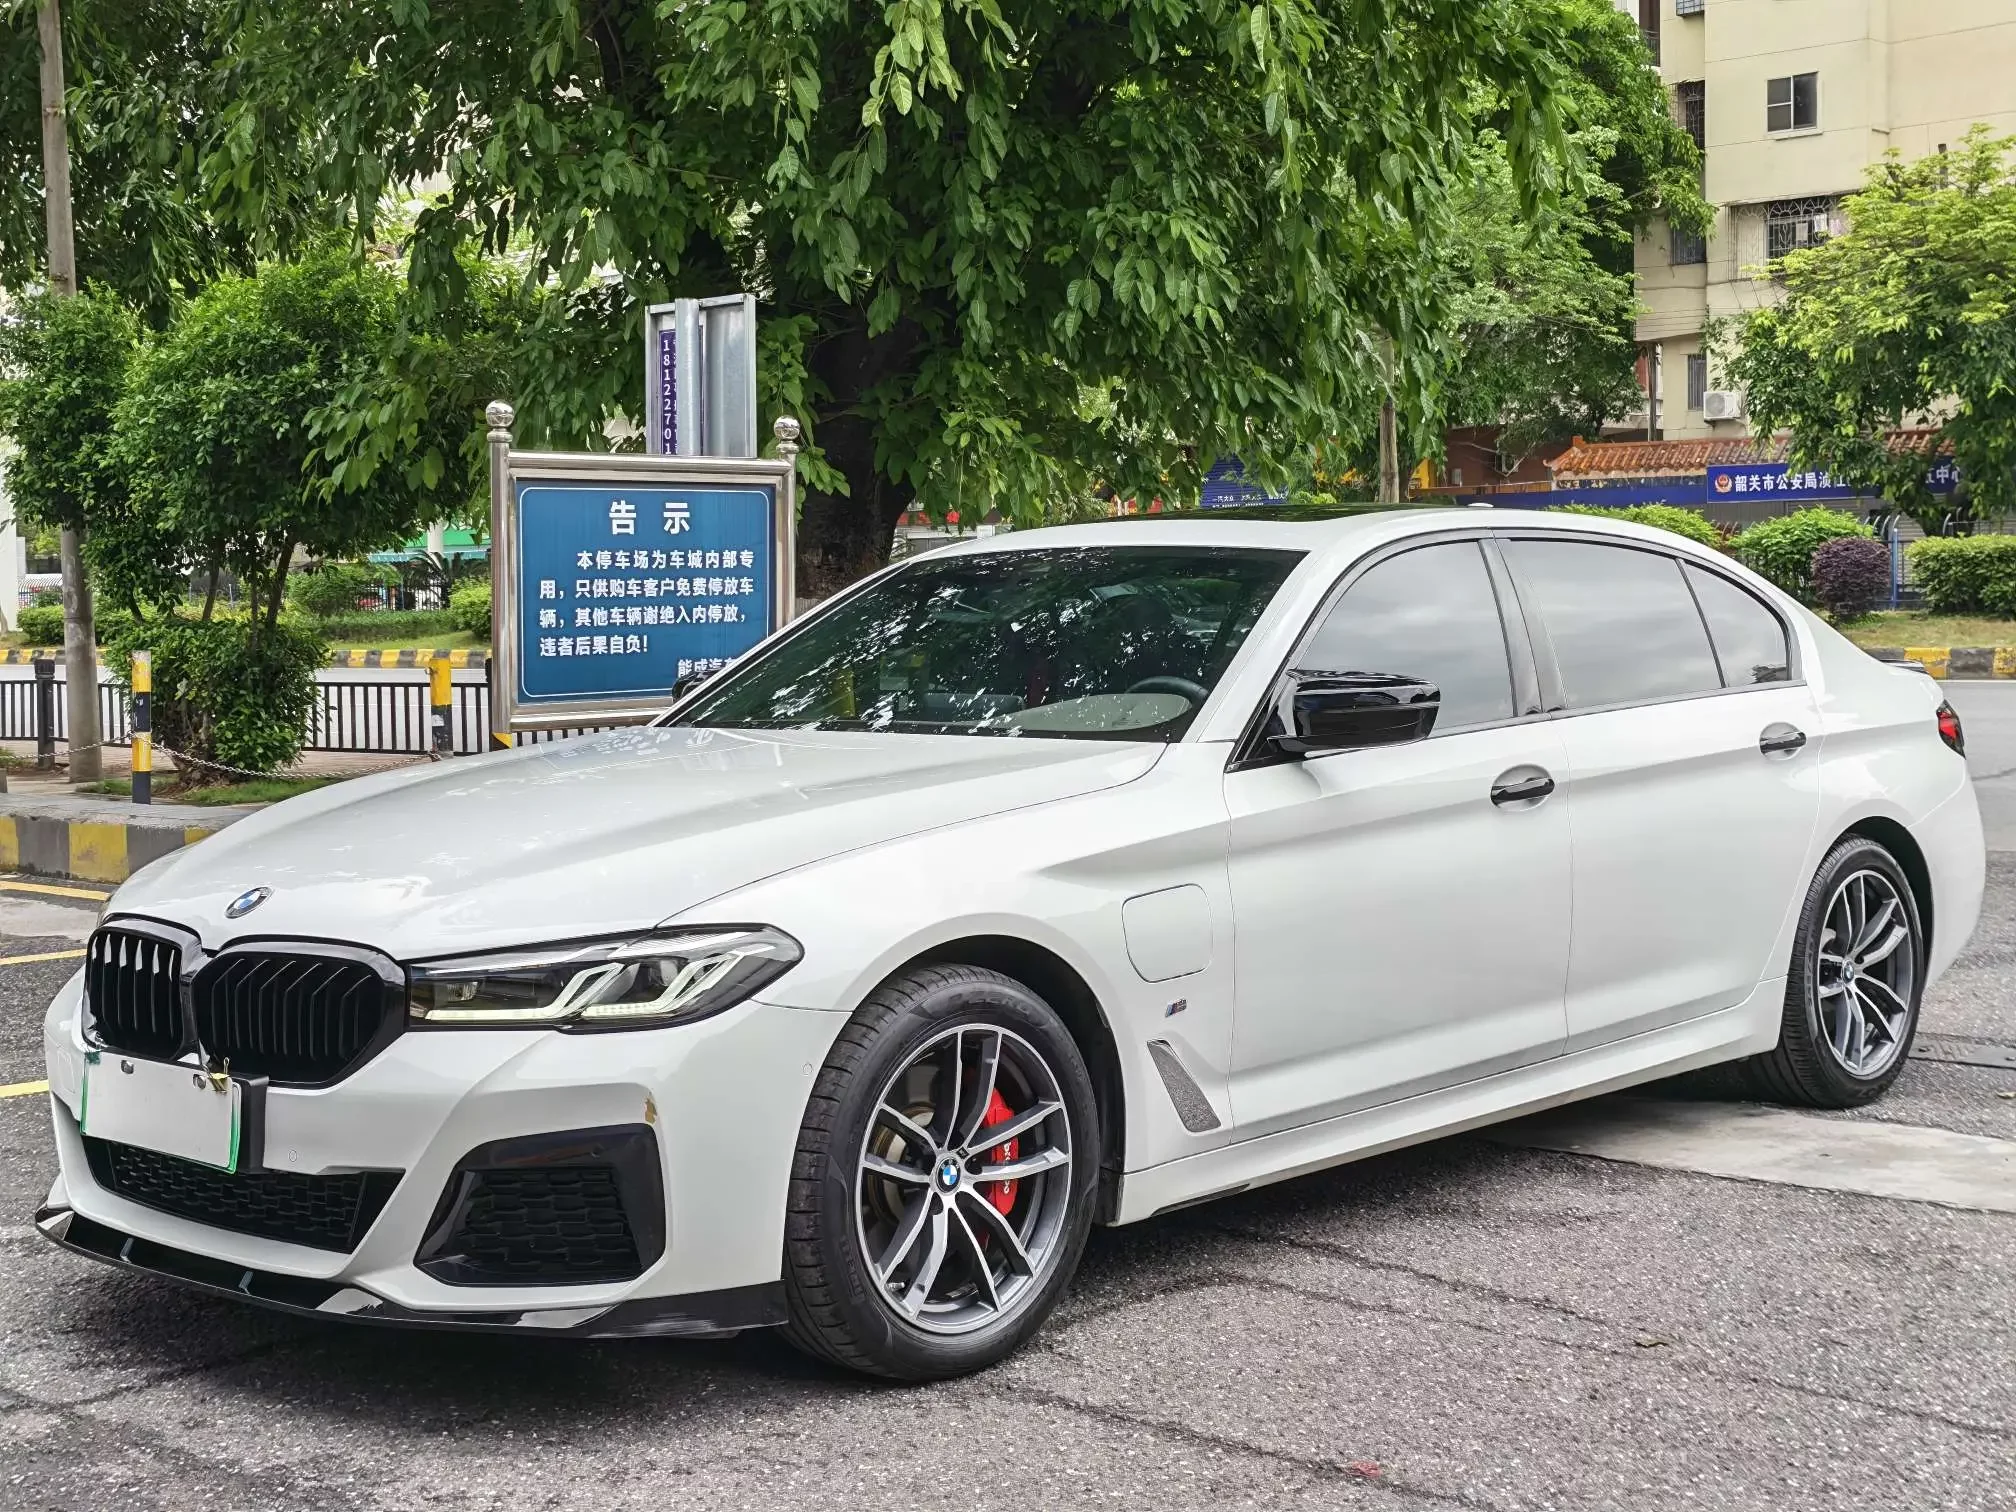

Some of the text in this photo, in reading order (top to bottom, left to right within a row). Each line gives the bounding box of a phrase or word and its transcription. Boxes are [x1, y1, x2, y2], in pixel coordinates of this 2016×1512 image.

[577, 550, 755, 570] 本停车场为车城内部专
